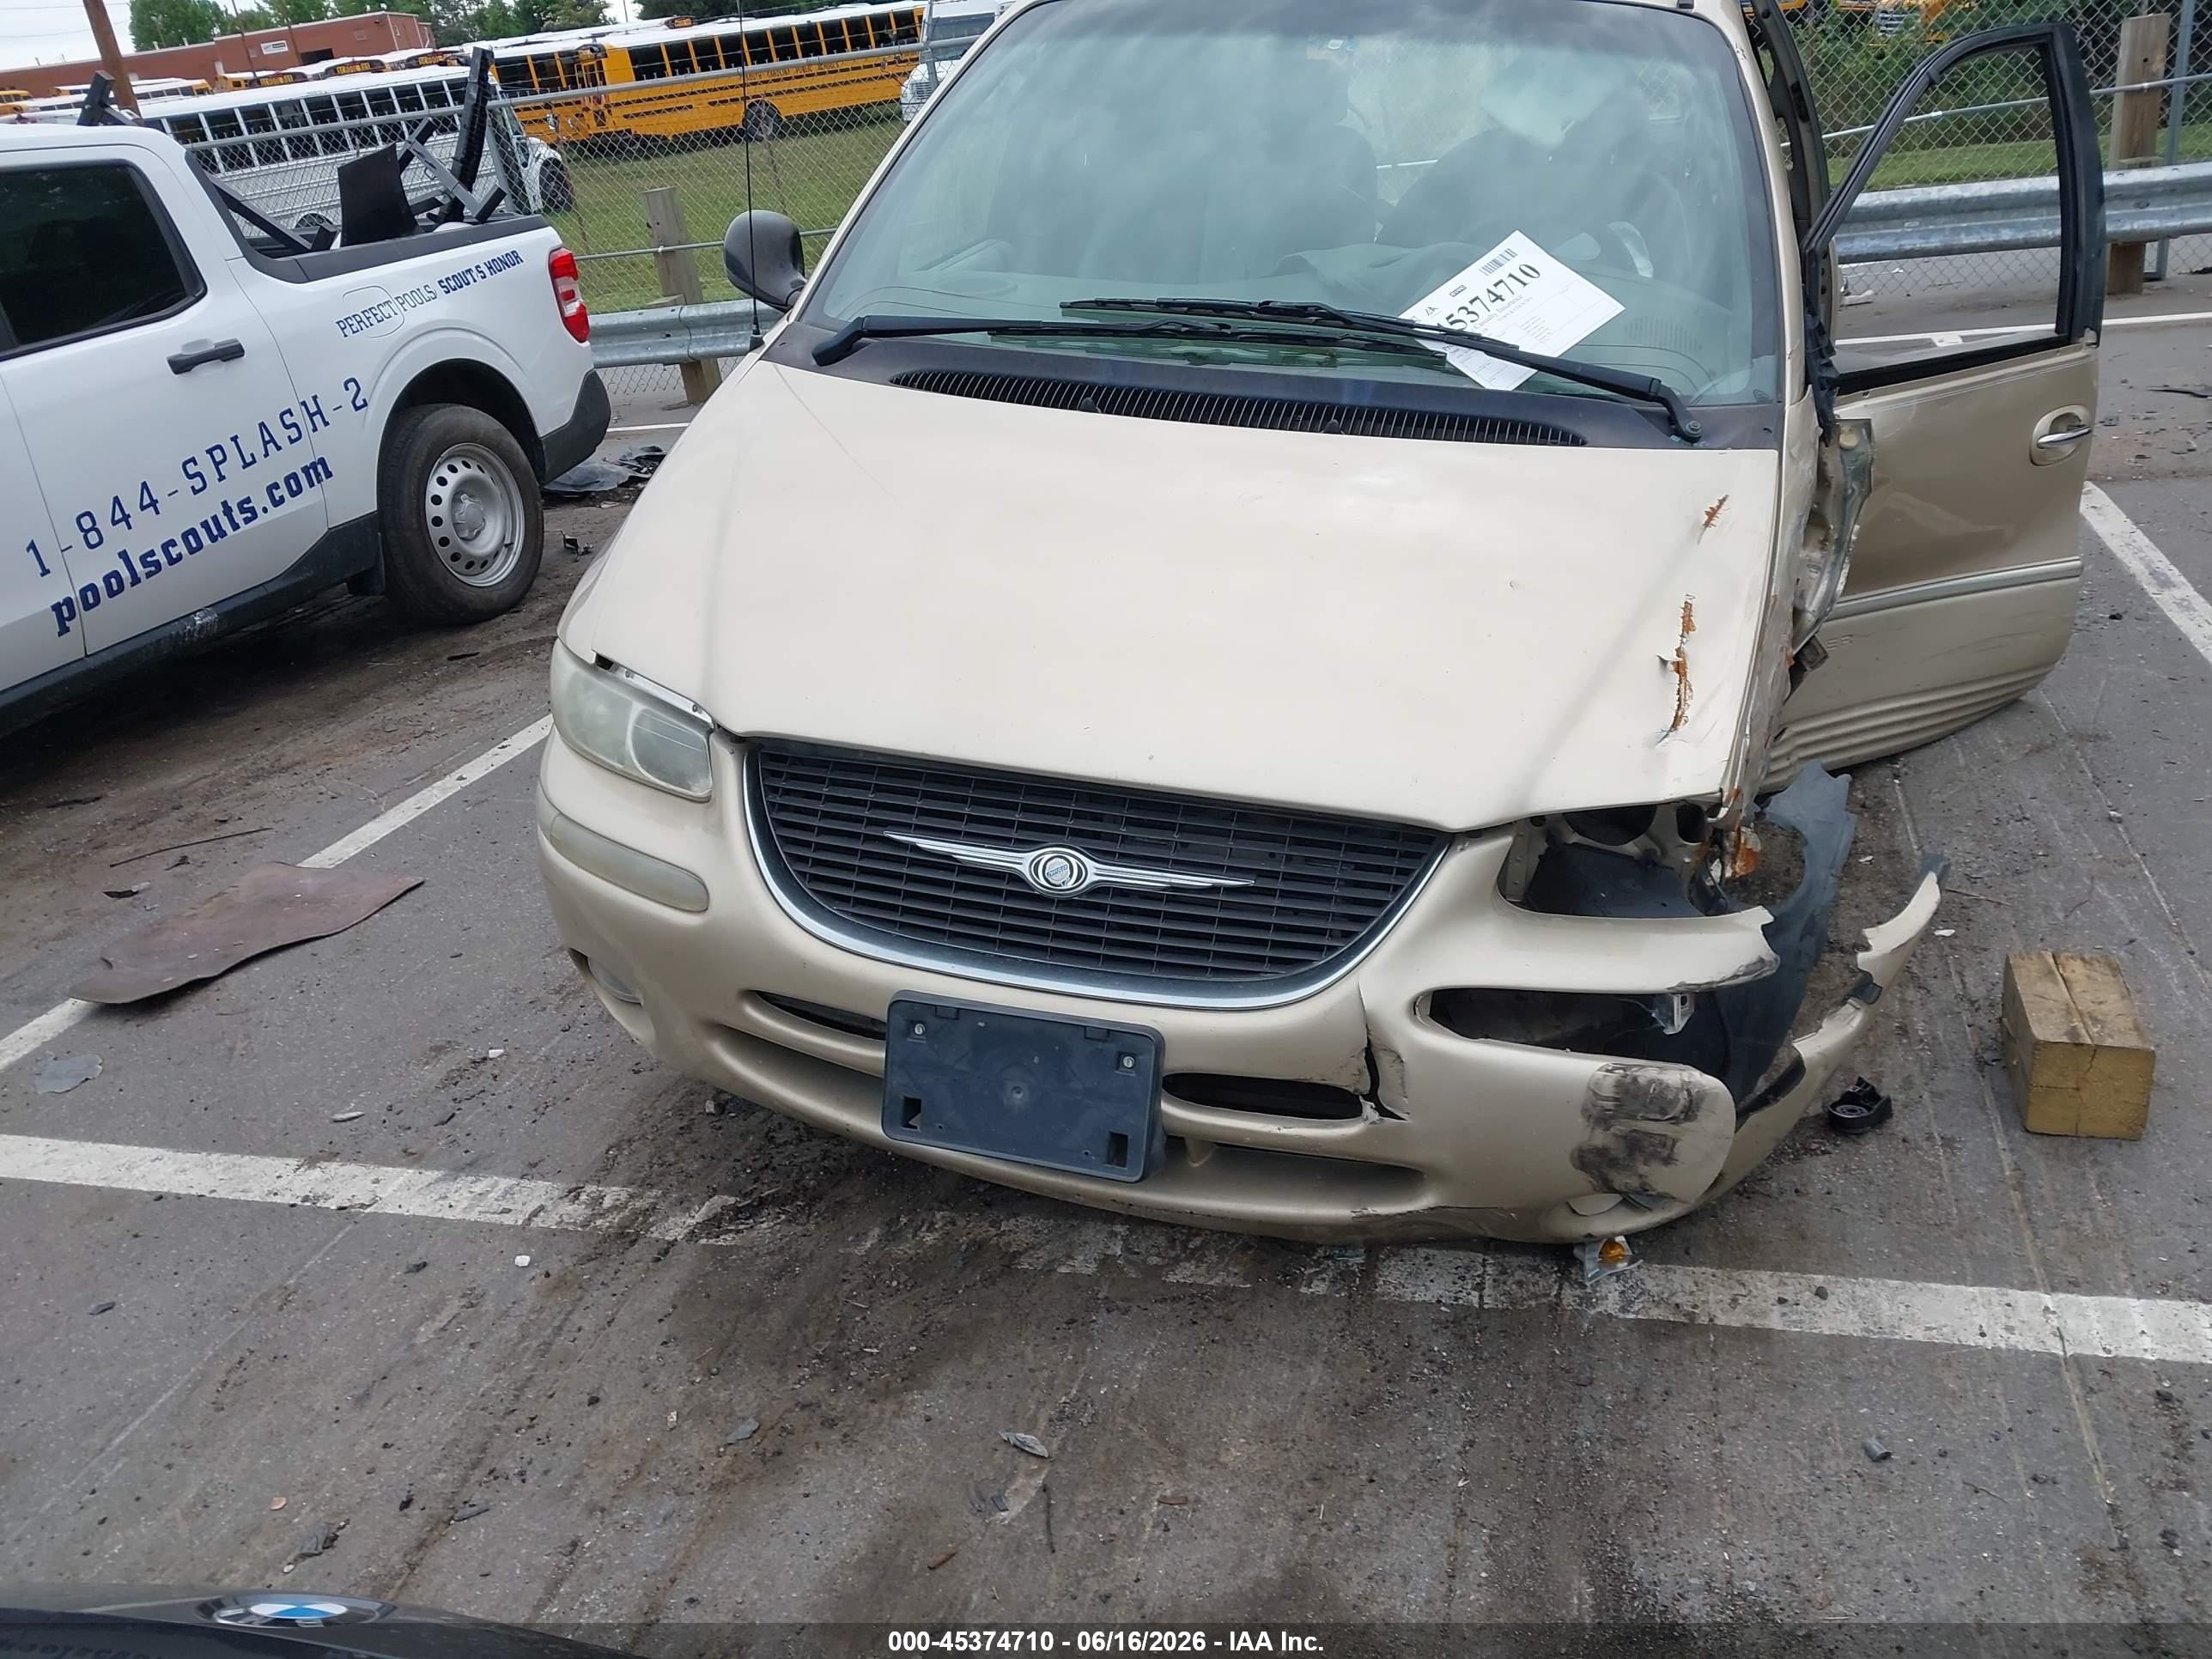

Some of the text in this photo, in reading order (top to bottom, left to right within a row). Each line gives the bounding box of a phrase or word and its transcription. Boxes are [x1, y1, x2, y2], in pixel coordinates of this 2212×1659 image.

[335, 300, 398, 337] PERFECT
[483, 250, 524, 276] HONOR
[26, 377, 368, 578] 1-844-SPLASH-2
[51, 456, 333, 637] poolscouts.com
